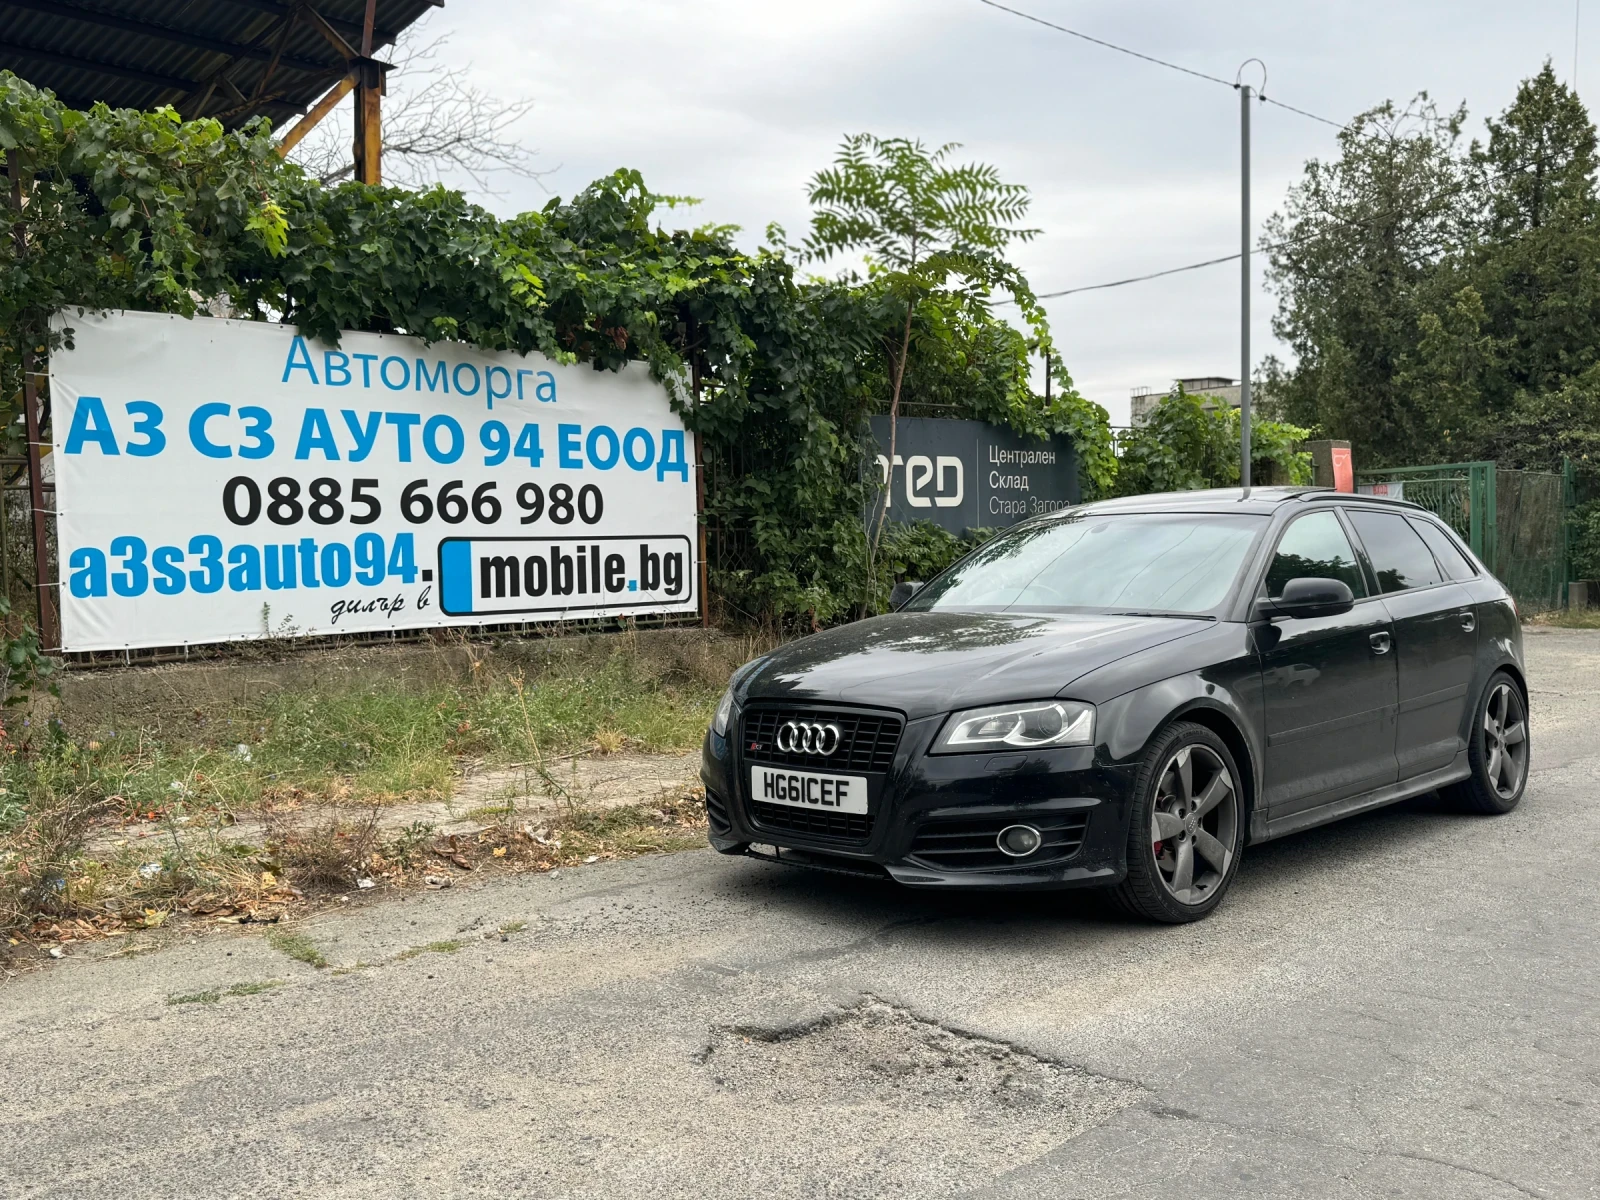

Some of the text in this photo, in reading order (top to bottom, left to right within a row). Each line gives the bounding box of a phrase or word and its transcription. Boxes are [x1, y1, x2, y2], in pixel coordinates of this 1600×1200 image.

[281, 336, 557, 410] Автоморга
[295, 408, 465, 465] АУТО
[479, 420, 544, 468] 94
[558, 424, 689, 482] ЕООД
[989, 445, 1056, 468] Централен
[222, 476, 604, 526] 0885 666 980
[989, 470, 1029, 491] Склад
[989, 495, 1027, 518] Стара
[480, 543, 683, 599] mobile.bg
[330, 593, 406, 625] дилър
